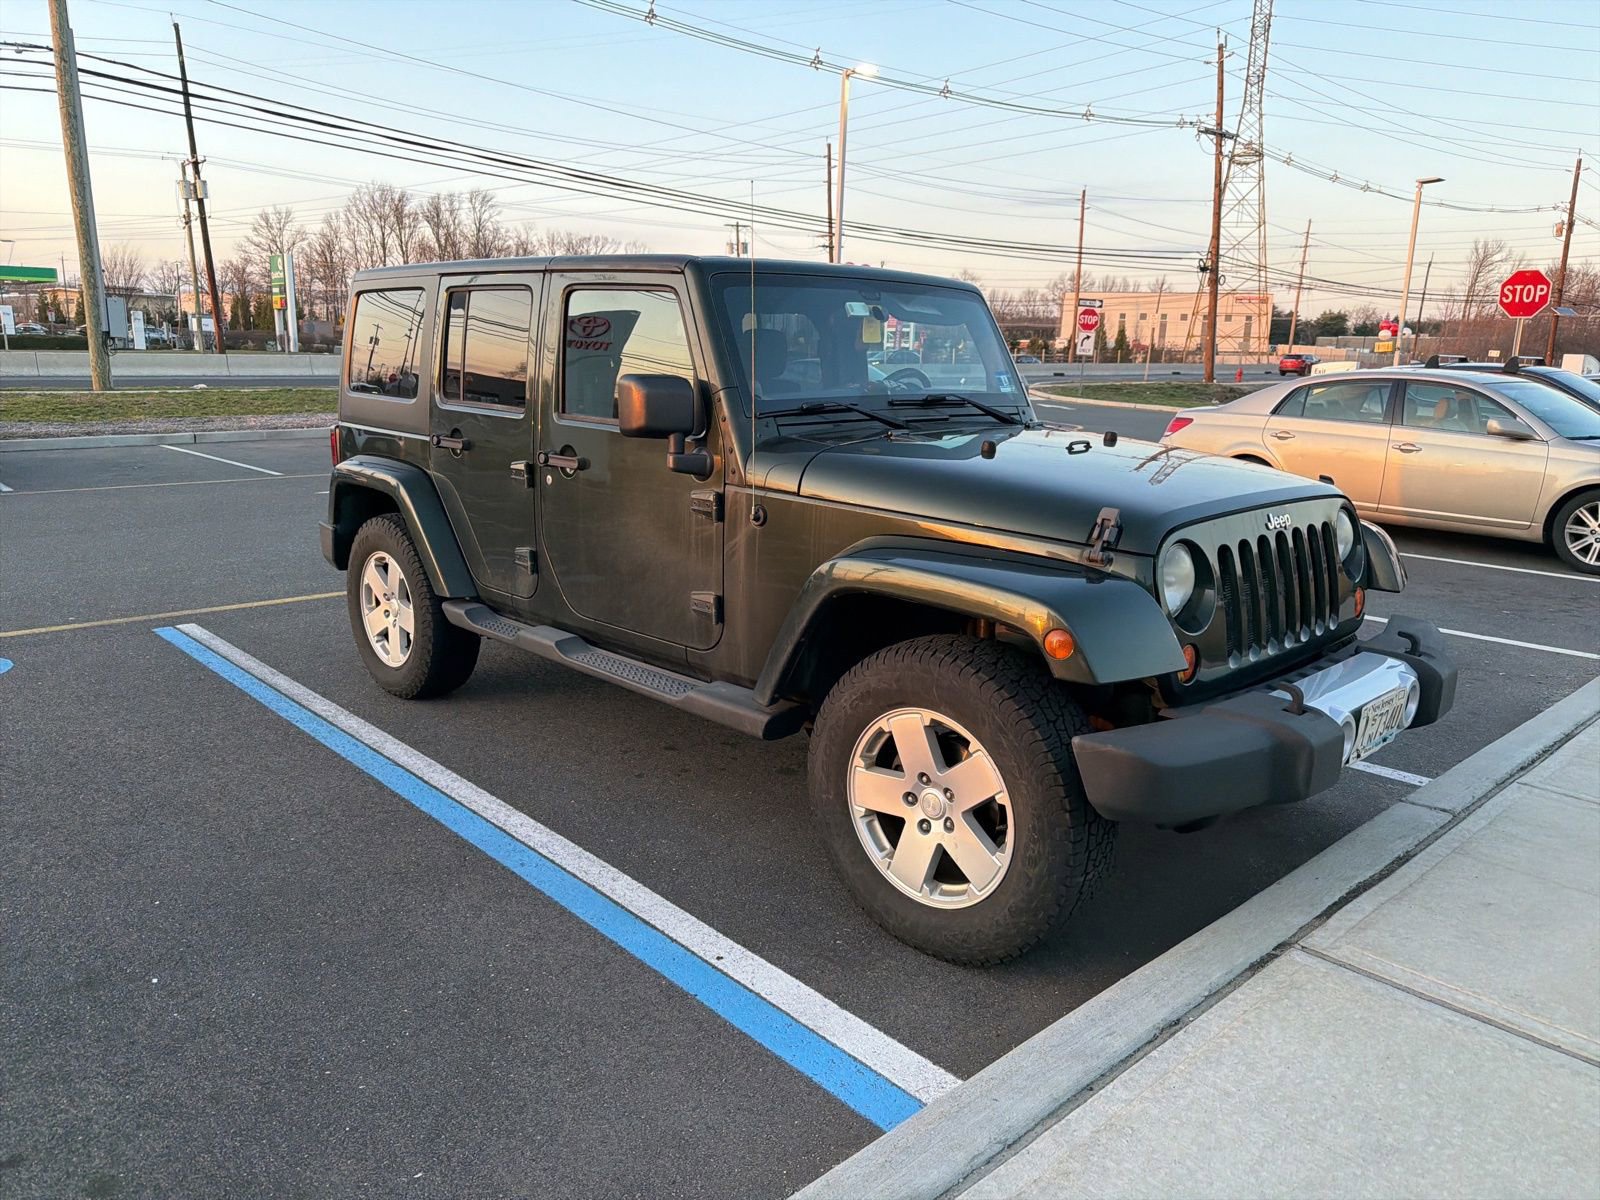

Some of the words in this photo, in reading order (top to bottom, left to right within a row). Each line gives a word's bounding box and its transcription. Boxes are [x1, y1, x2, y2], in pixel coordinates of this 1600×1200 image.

[1502, 284, 1547, 303] STOP
[1079, 314, 1098, 325] STOP
[1265, 512, 1292, 531] Jeep
